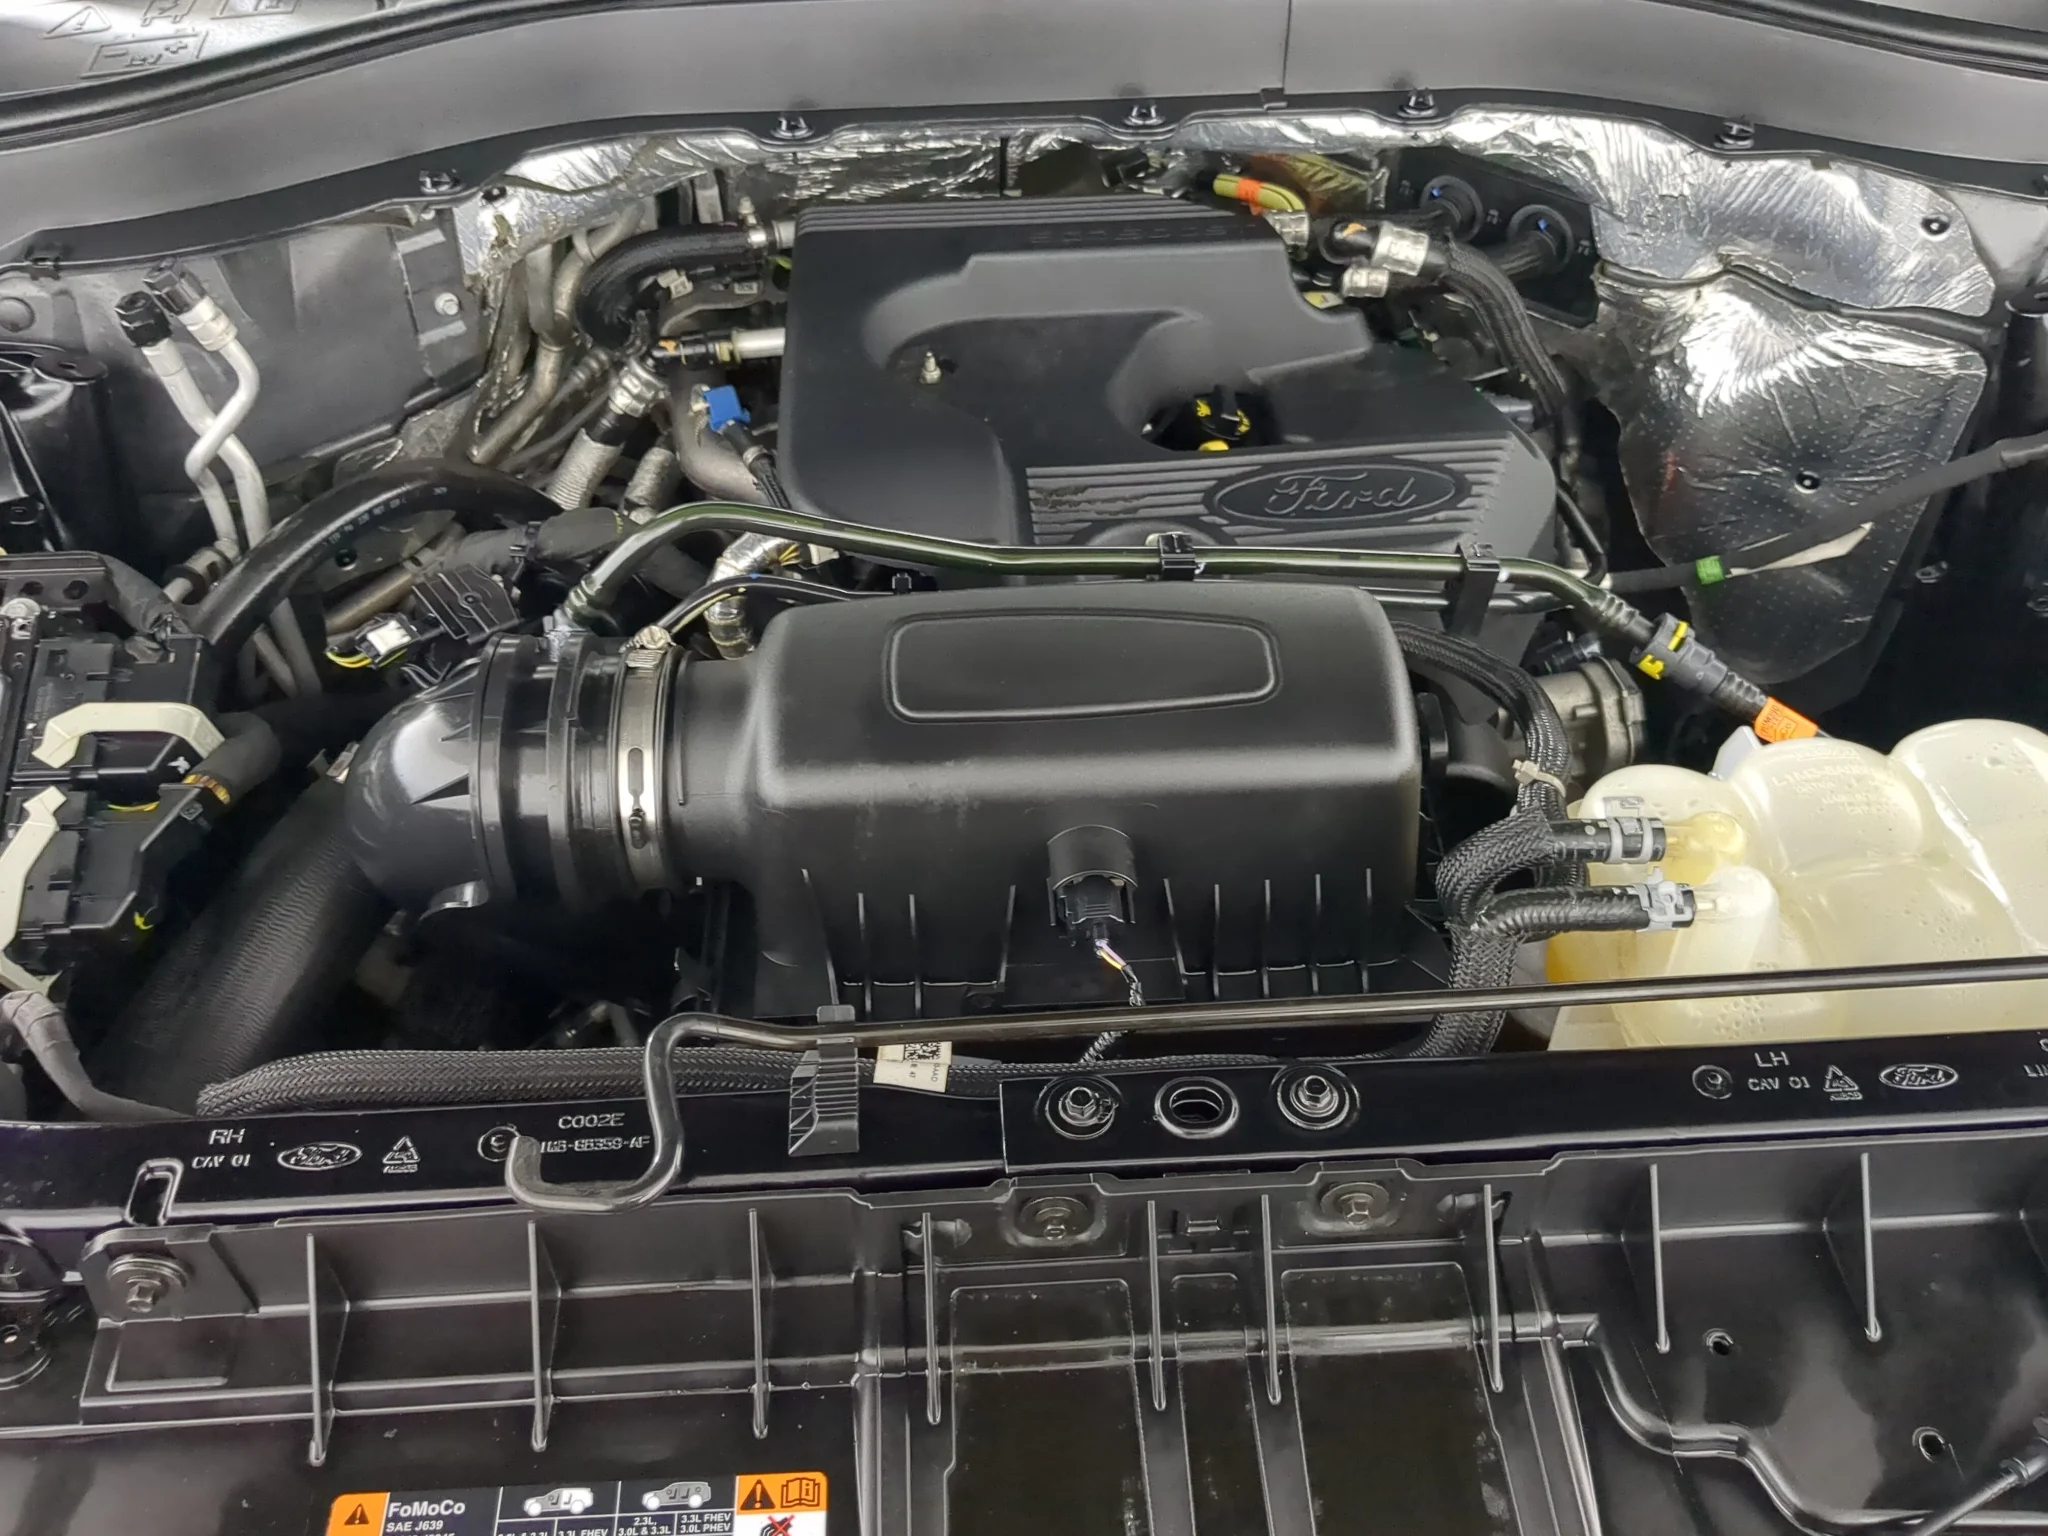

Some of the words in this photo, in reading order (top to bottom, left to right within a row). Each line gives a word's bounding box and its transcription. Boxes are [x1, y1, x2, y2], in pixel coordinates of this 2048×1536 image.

[1264, 471, 1417, 516] Ford
[1754, 1051, 1790, 1067] LH
[1747, 1077, 1780, 1091] CAV
[1890, 1065, 1948, 1087] Ford
[208, 1128, 245, 1145] RH
[287, 1143, 352, 1168] Ford
[387, 1499, 466, 1518] FoMoCo
[386, 1521, 413, 1532] SAE
[415, 1520, 444, 1531] J639
[681, 1514, 702, 1523] 3.3L
[703, 1513, 732, 1522] FHEV
[618, 1527, 639, 1536] 3.0L
[640, 1527, 649, 1535] &
[650, 1526, 672, 1535] 3.3L
[680, 1525, 701, 1533] 3.0L
[703, 1523, 731, 1532] PHEV
